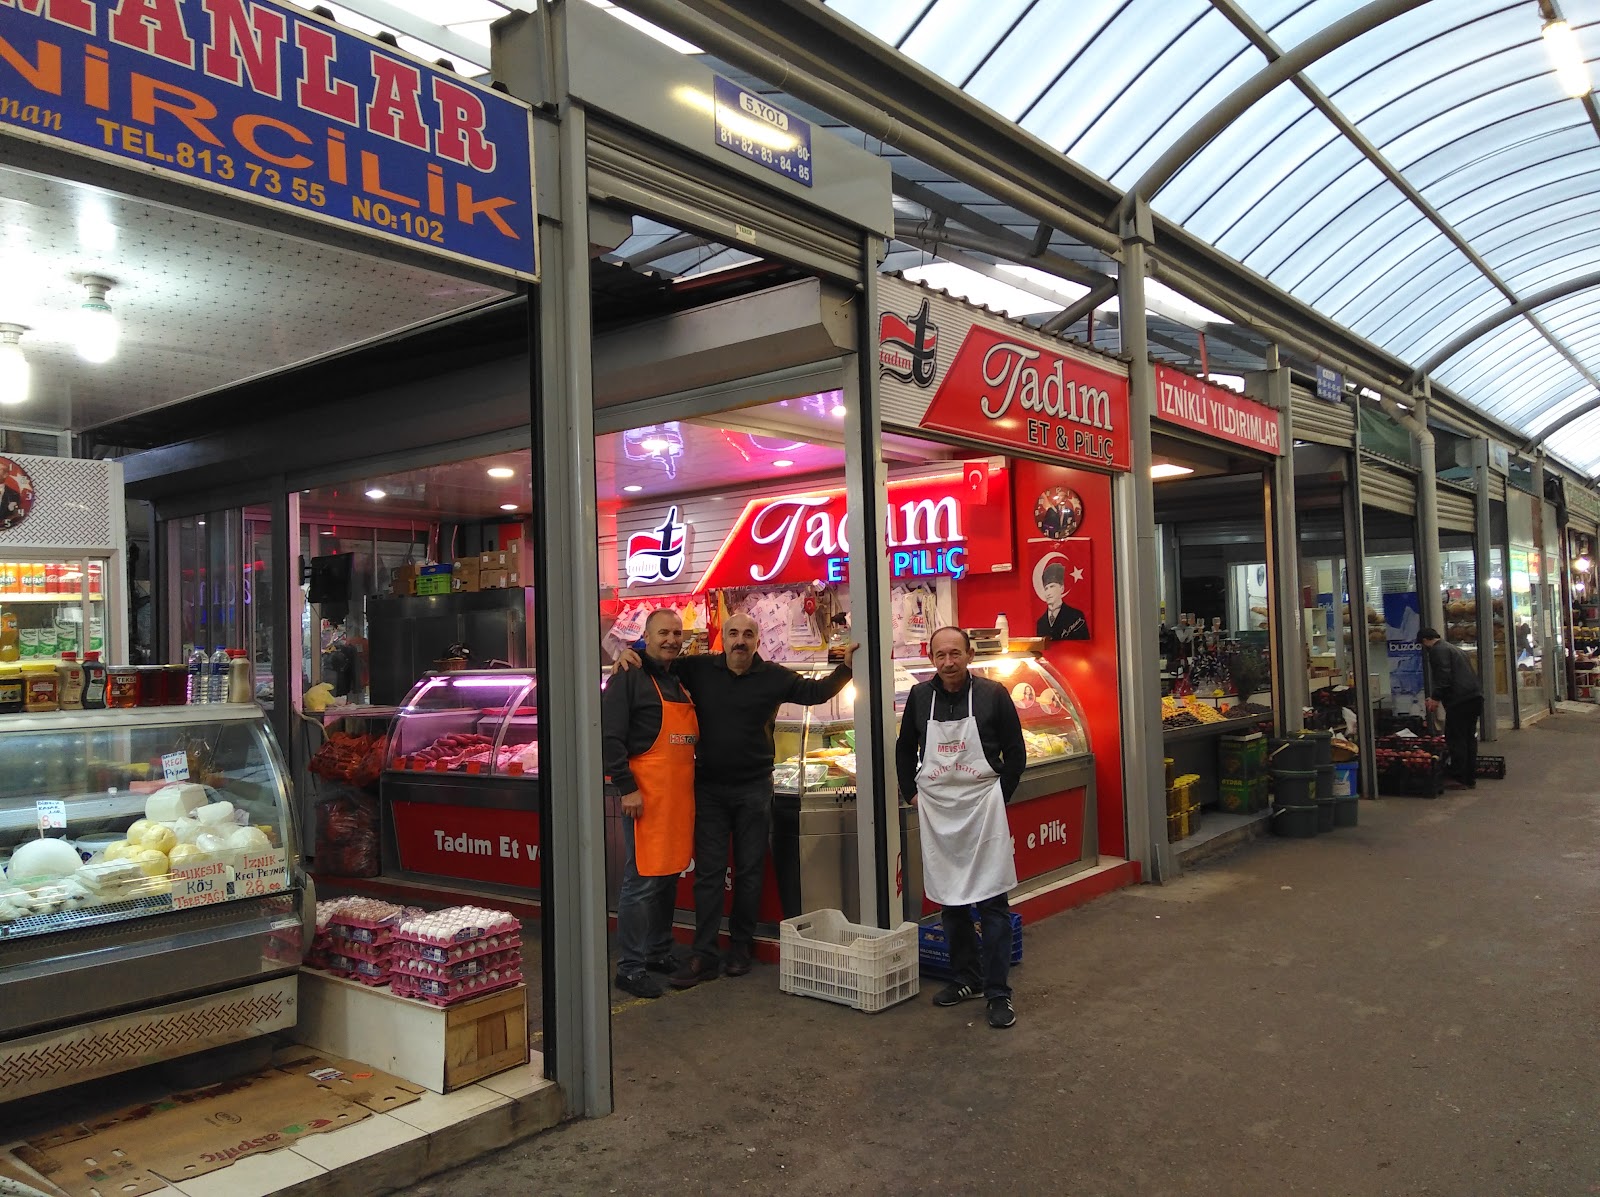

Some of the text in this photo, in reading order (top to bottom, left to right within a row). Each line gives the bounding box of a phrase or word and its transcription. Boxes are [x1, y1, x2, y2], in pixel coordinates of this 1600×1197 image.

[0, 0, 496, 173] ANLAR
[746, 97, 784, 127] 5.YOL
[96, 118, 445, 243] TEL.813 73 55 NO:102
[980, 341, 1114, 432] Tadım
[1027, 417, 1050, 446] ET
[1056, 426, 1069, 451] &
[1209, 399, 1278, 449] YILDIRIMLAR
[434, 829, 541, 861] Tadım Et v
[1039, 819, 1067, 846] Piliç
[245, 879, 266, 897] 28
